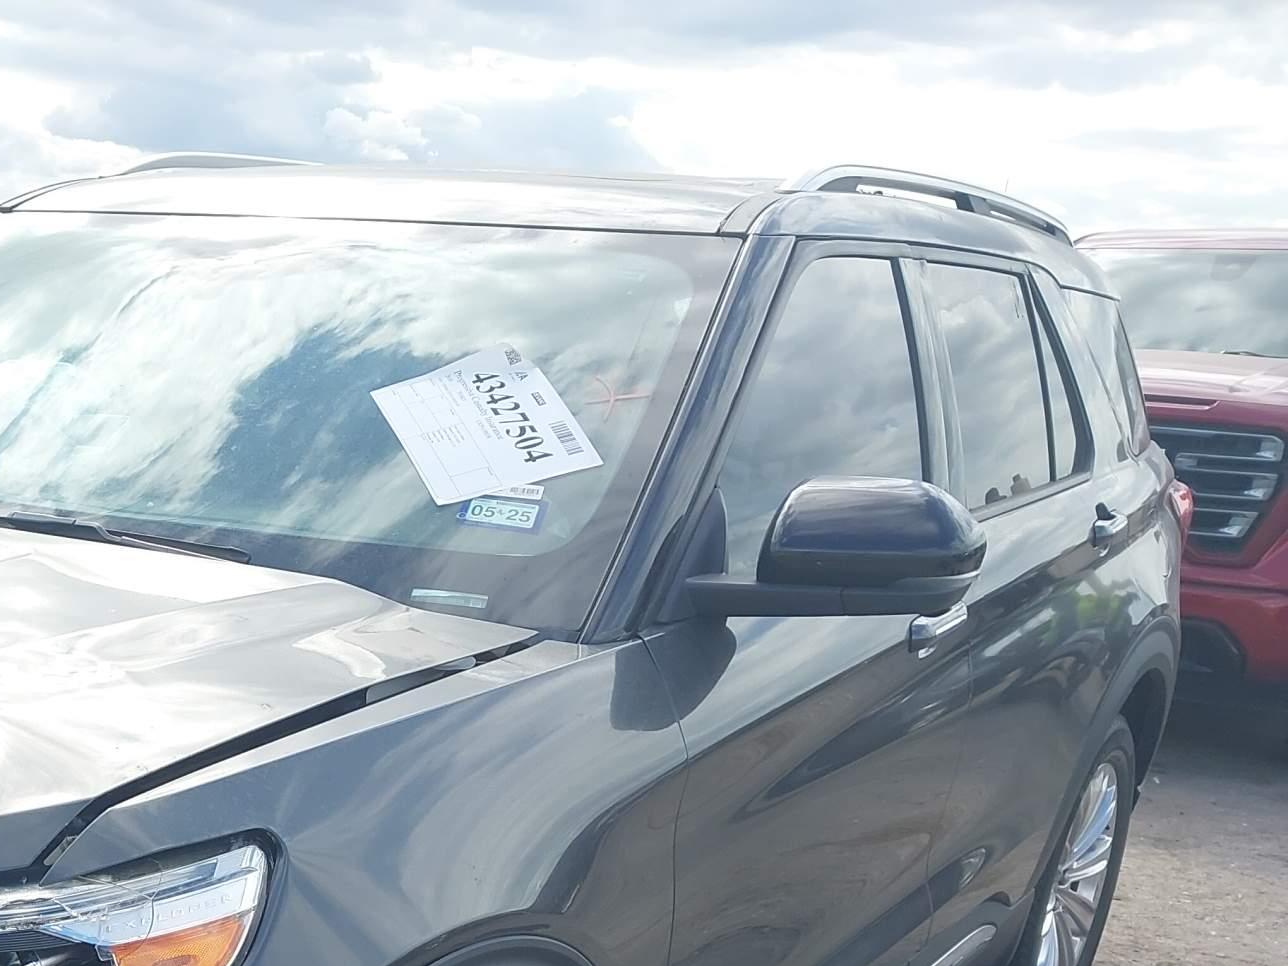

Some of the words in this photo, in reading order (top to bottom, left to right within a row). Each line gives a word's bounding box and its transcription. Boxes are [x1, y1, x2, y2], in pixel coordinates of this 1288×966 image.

[471, 372, 554, 463] 43427504
[471, 504, 496, 518] 05
[505, 508, 533, 523] 25
